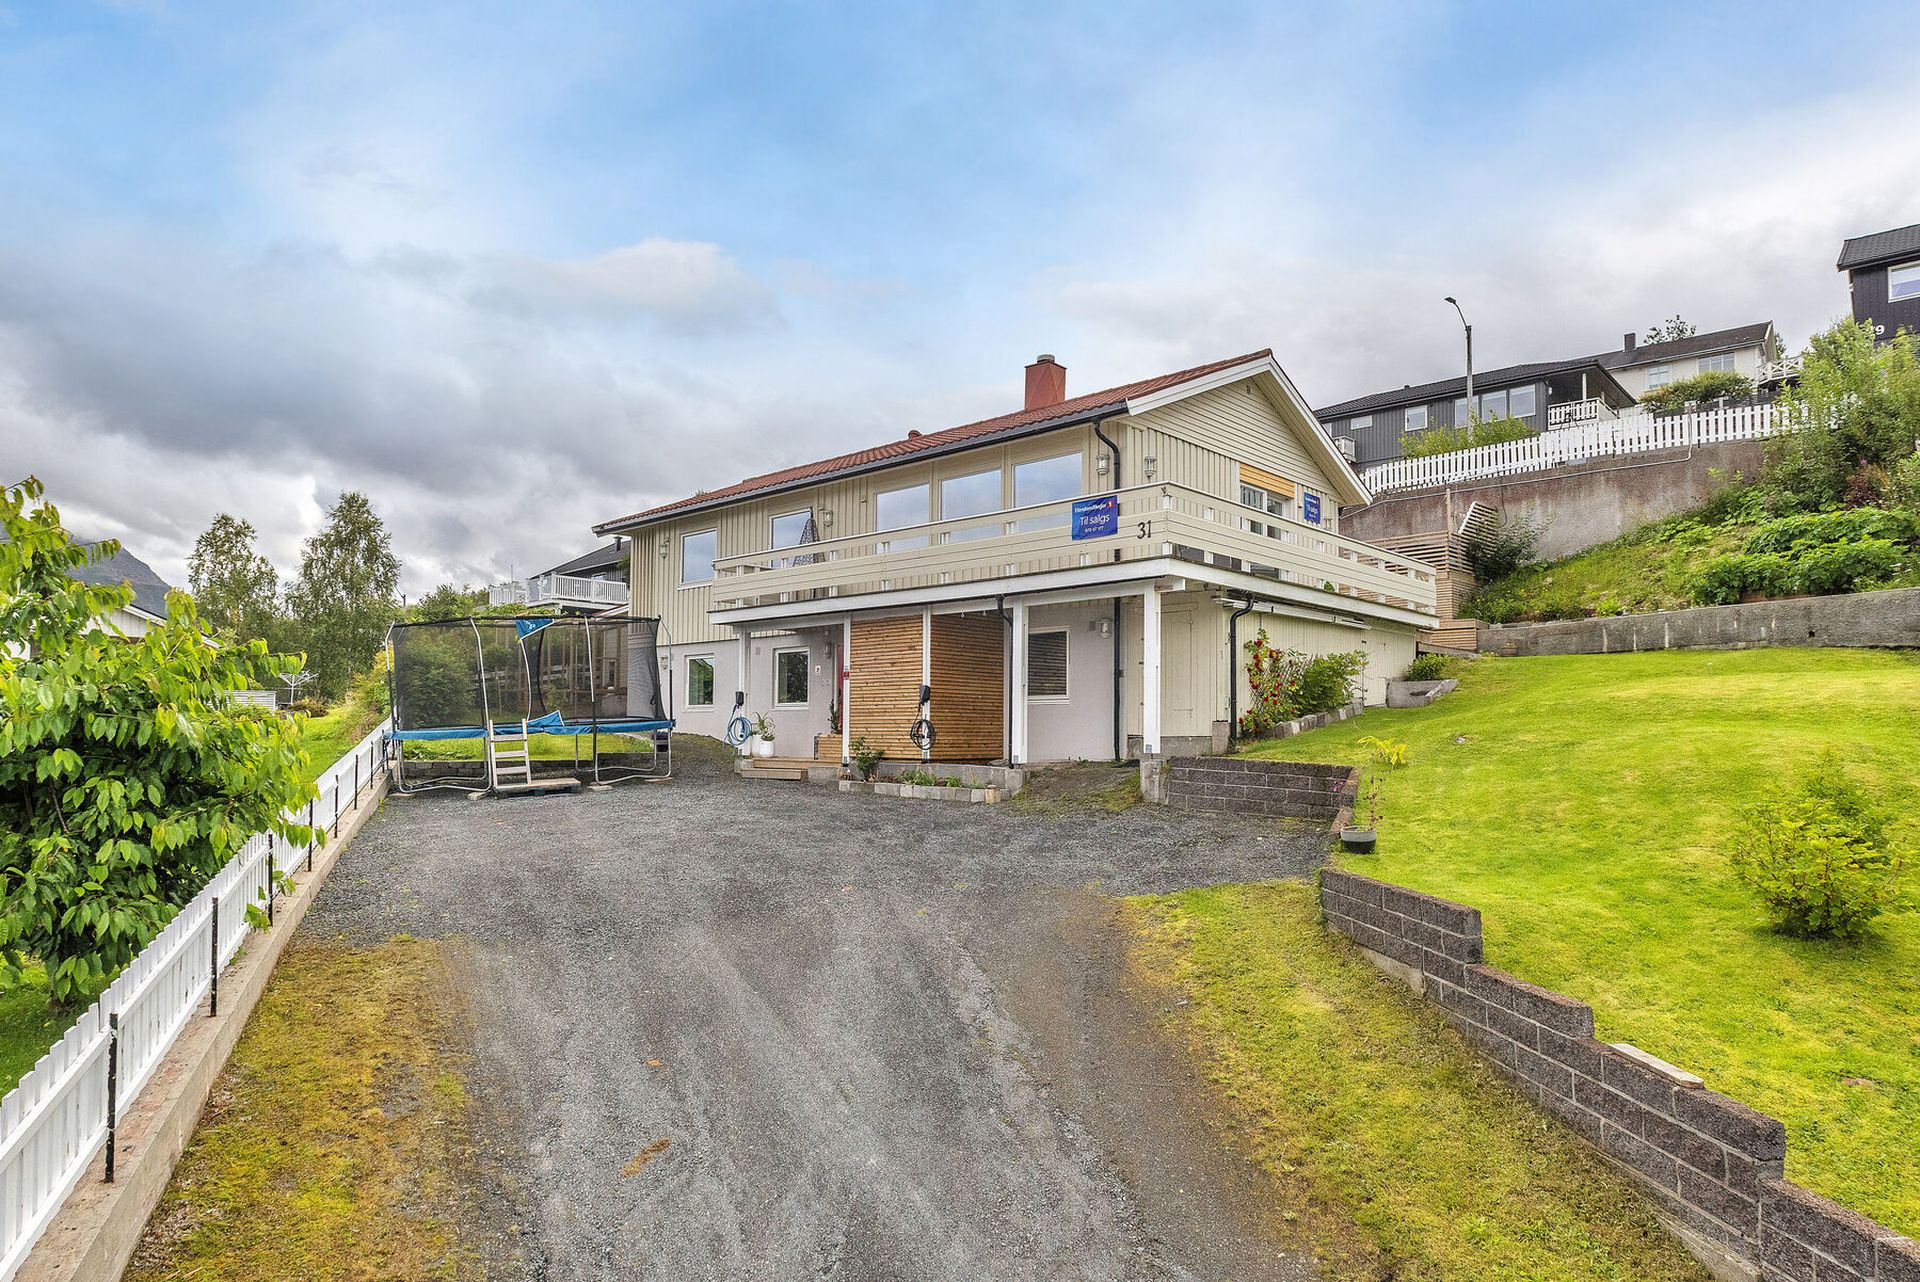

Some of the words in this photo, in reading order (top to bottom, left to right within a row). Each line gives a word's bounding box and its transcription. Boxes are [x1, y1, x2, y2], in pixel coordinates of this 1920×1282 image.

[1080, 515, 1089, 526] Til
[1089, 514, 1110, 525] salgs
[1137, 520, 1152, 539] 31
